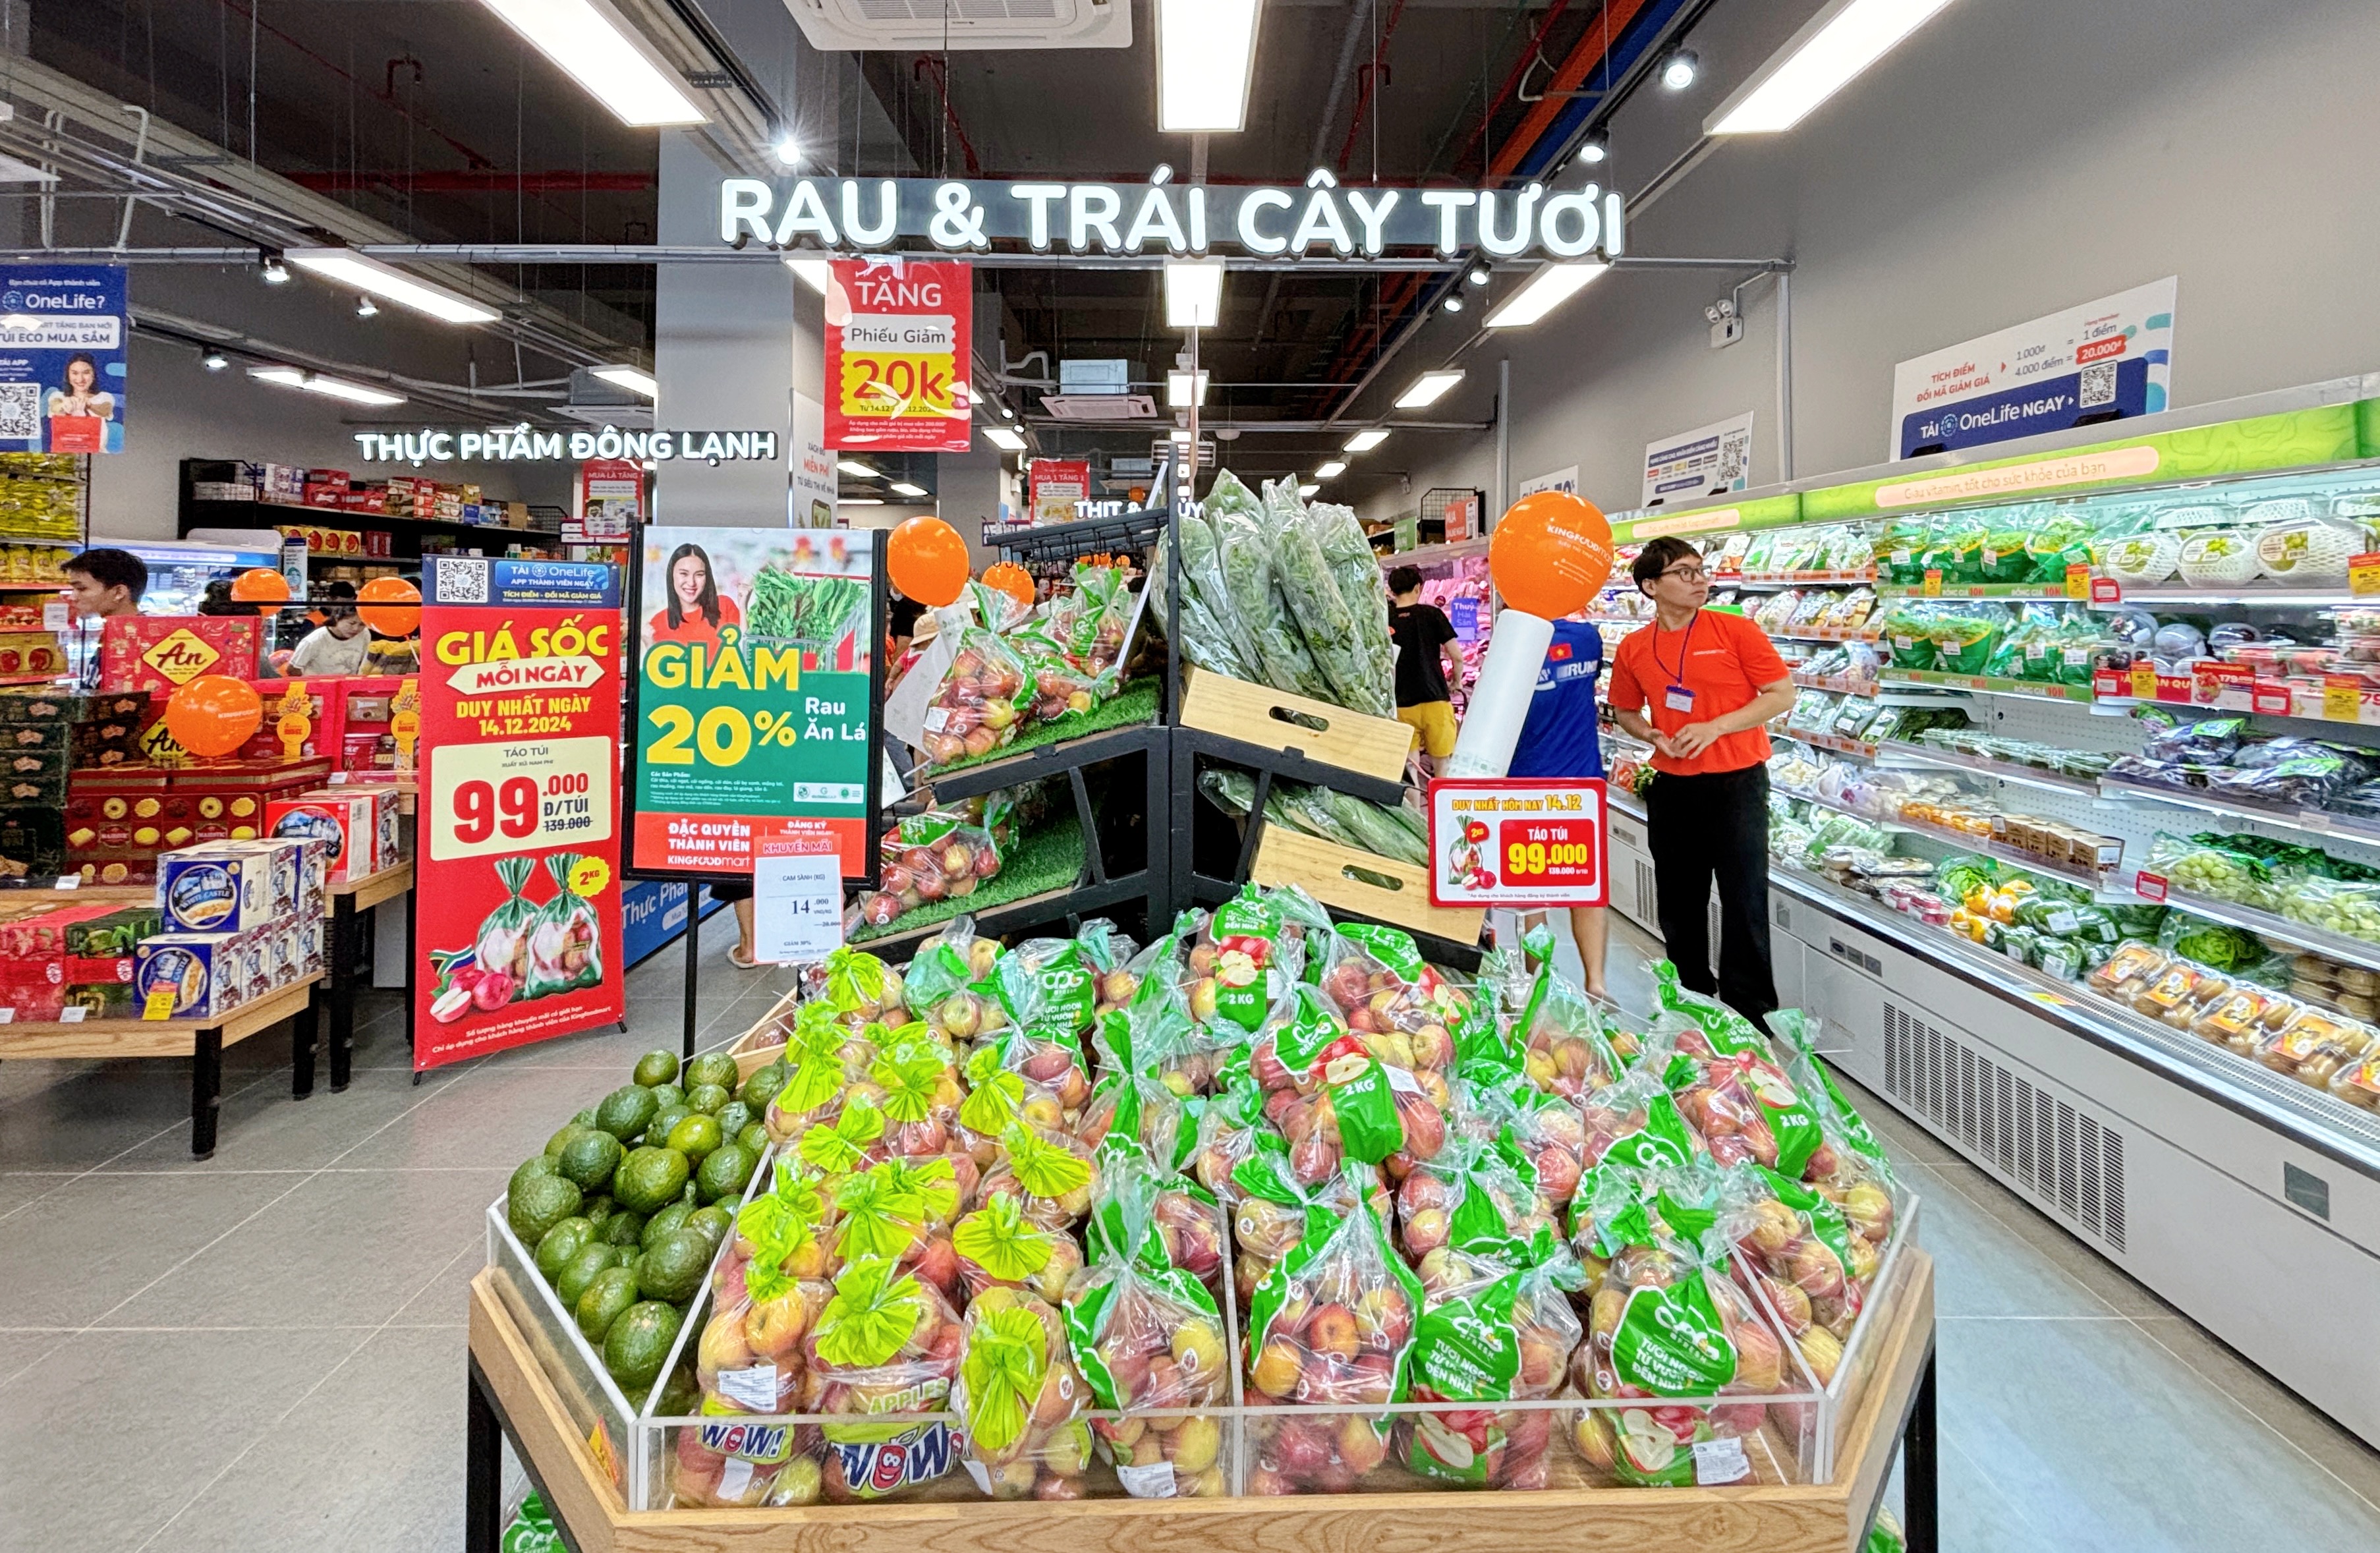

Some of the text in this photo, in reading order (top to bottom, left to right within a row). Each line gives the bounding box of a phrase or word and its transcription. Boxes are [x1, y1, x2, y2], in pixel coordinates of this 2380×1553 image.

[721, 164, 1622, 256] RAU & TRÁI CÂY TƯƠI
[26, 294, 105, 308] OneLife?
[855, 275, 942, 312] TẶNG
[18, 331, 109, 343] ECO MUA SẮM
[851, 327, 945, 343] Phiếu Giảm
[2084, 330, 2089, 340] 1
[2091, 324, 2116, 338] điểm
[1931, 363, 1975, 383] TÍCH ĐIỂM
[2016, 362, 2041, 377] 4.000
[2042, 357, 2063, 372] điểm
[1933, 384, 1947, 396] MÃ
[1949, 380, 1972, 394] GIẢM
[1974, 372, 1990, 387] GIÁ
[1921, 396, 2066, 439] TẢI OneLife NGAY
[354, 422, 776, 467] THỰC PHẨM ĐÔNG LẠNH
[1965, 477, 1980, 491] tốt
[1982, 476, 2000, 488] cho
[2003, 473, 2022, 487] sức
[2056, 465, 2077, 479] của
[2082, 462, 2106, 476] bạn
[550, 567, 594, 577] OneLife
[521, 590, 538, 598] ĐIỂM
[2045, 587, 2062, 596] 10K
[436, 614, 608, 665] GIÁ SỐC
[646, 627, 800, 692] GIẢM
[476, 660, 588, 689] MỖI NGÀY
[2047, 687, 2064, 696] 10K
[457, 693, 591, 719] DUY NHẤT NGÀY
[805, 696, 845, 716] Rau
[480, 715, 572, 736] 14.12.2024
[646, 704, 797, 767] 20%
[804, 718, 866, 741] Ăn Lá
[504, 746, 549, 757] TÁO TÚI
[453, 772, 588, 844] 99 .000
[544, 795, 589, 817] Đ/TÚI
[1452, 795, 1582, 811] DUY NHẤT HÔM NAY 14.12
[544, 816, 591, 832] 139.000
[668, 818, 751, 837] ĐẶC QUYỀN
[1527, 826, 1568, 841] TÁO TÚI
[668, 837, 750, 852] THÀNH VIÊN
[763, 839, 832, 854] KHUYẾN MÃI
[667, 855, 751, 868] KINGFOODmart
[1508, 842, 1587, 875] 99.000
[622, 895, 656, 929] Thực
[791, 899, 810, 915] 14
[1229, 994, 1255, 1005] 2 KG
[1344, 1079, 1375, 1096] 2 KG
[1780, 1114, 1809, 1127] 2 KG
[1435, 1338, 1461, 1363] TƯƠI
[1641, 1338, 1668, 1361] TƯƠI
[1425, 1361, 1448, 1381] ĐẾN
[1632, 1362, 1656, 1384] ĐẾN
[868, 1376, 950, 1415] APPLES
[700, 1422, 787, 1458] WOW!
